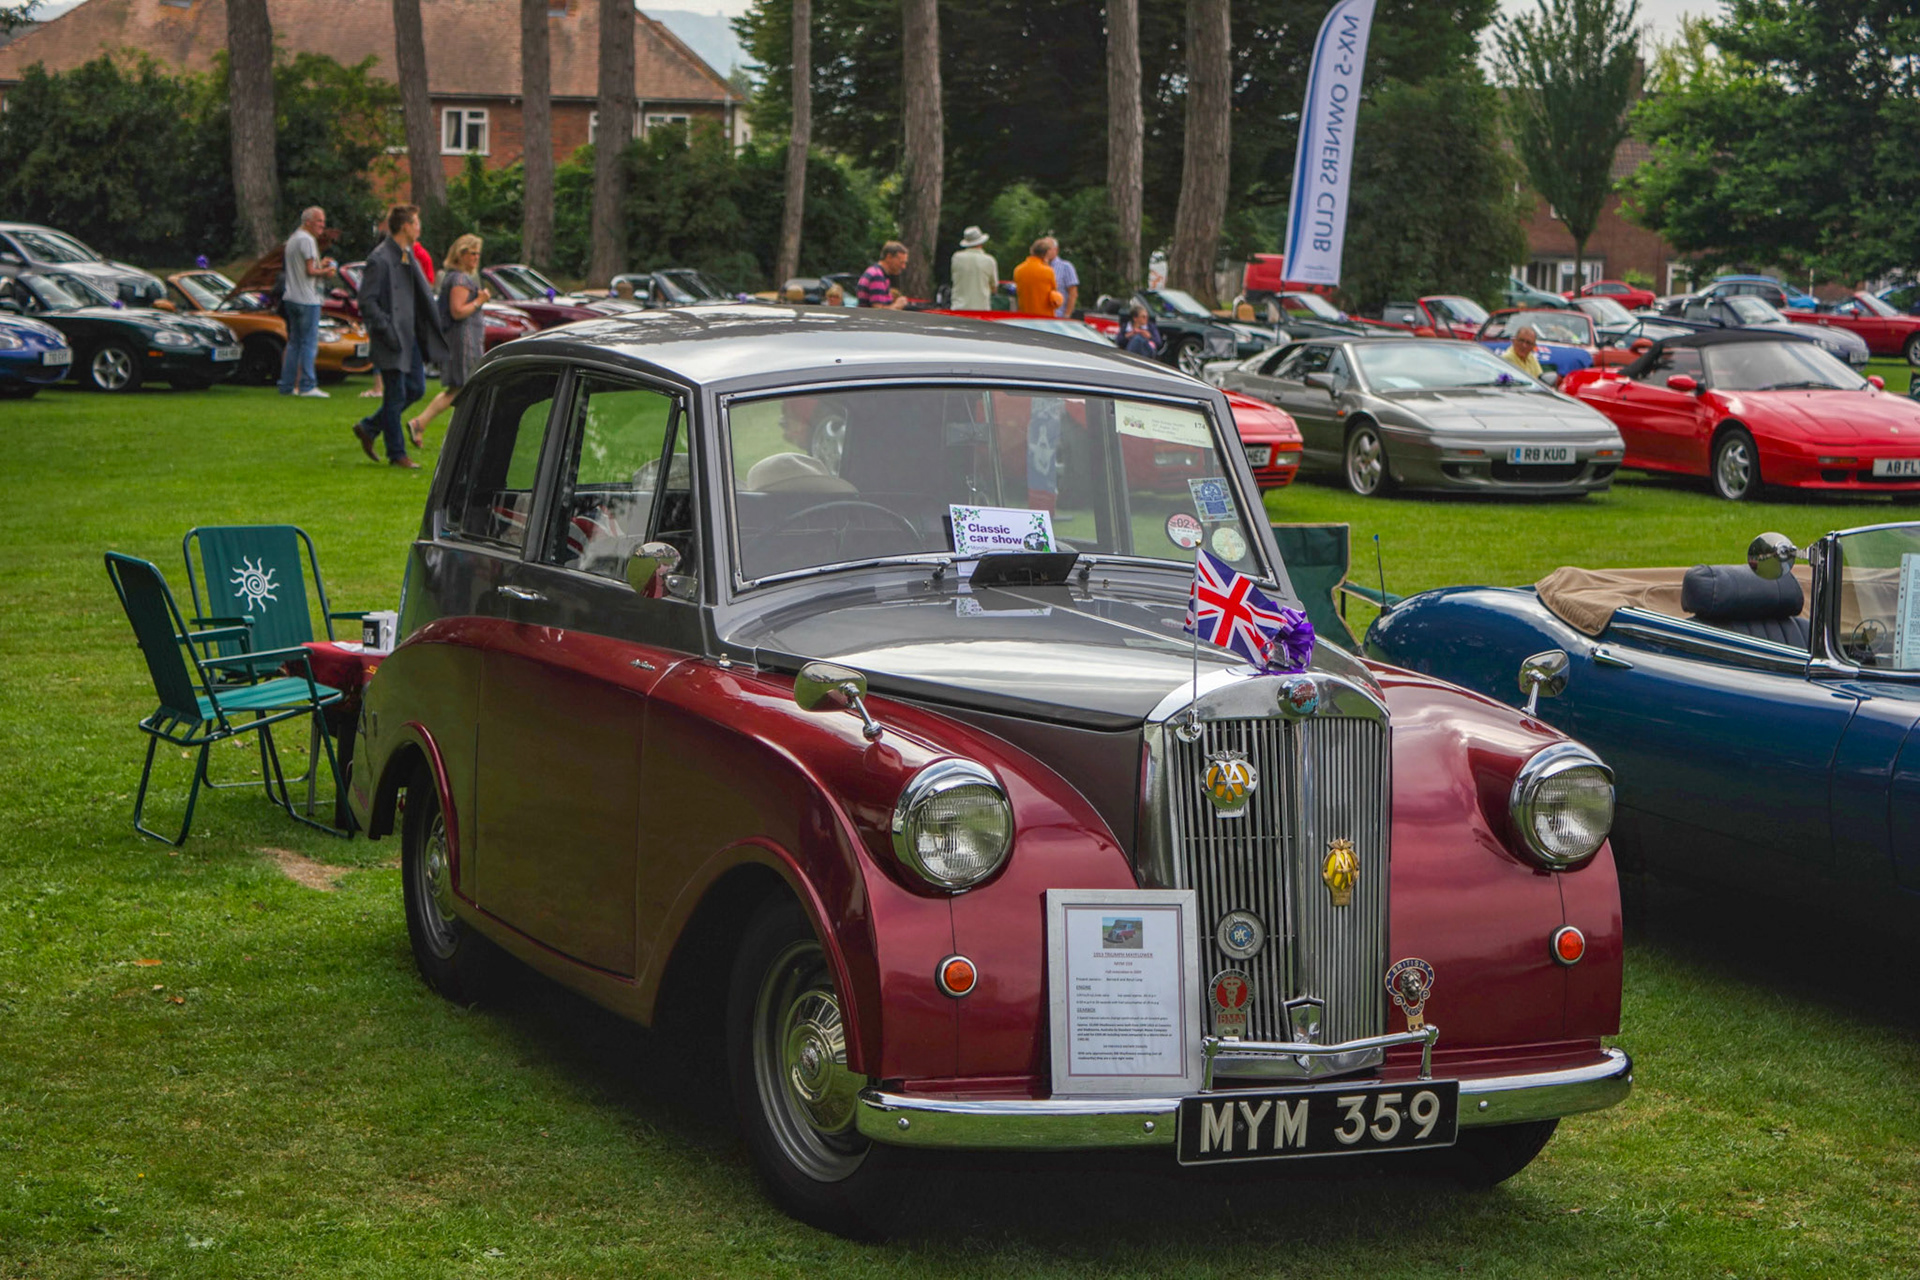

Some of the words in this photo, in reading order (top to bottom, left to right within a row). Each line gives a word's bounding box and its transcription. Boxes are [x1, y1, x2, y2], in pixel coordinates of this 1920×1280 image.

[1194, 421, 1206, 430] 174
[1525, 448, 1540, 461] R8
[1904, 460, 1920, 474] FL
[968, 523, 1011, 535] Classic
[969, 535, 989, 543] car
[992, 535, 1022, 545] show
[1213, 760, 1245, 797] AA
[1234, 928, 1248, 942] RAC
[1391, 960, 1425, 974] BRITISH
[1199, 1098, 1310, 1153] MYM
[1333, 1090, 1440, 1145] 359
